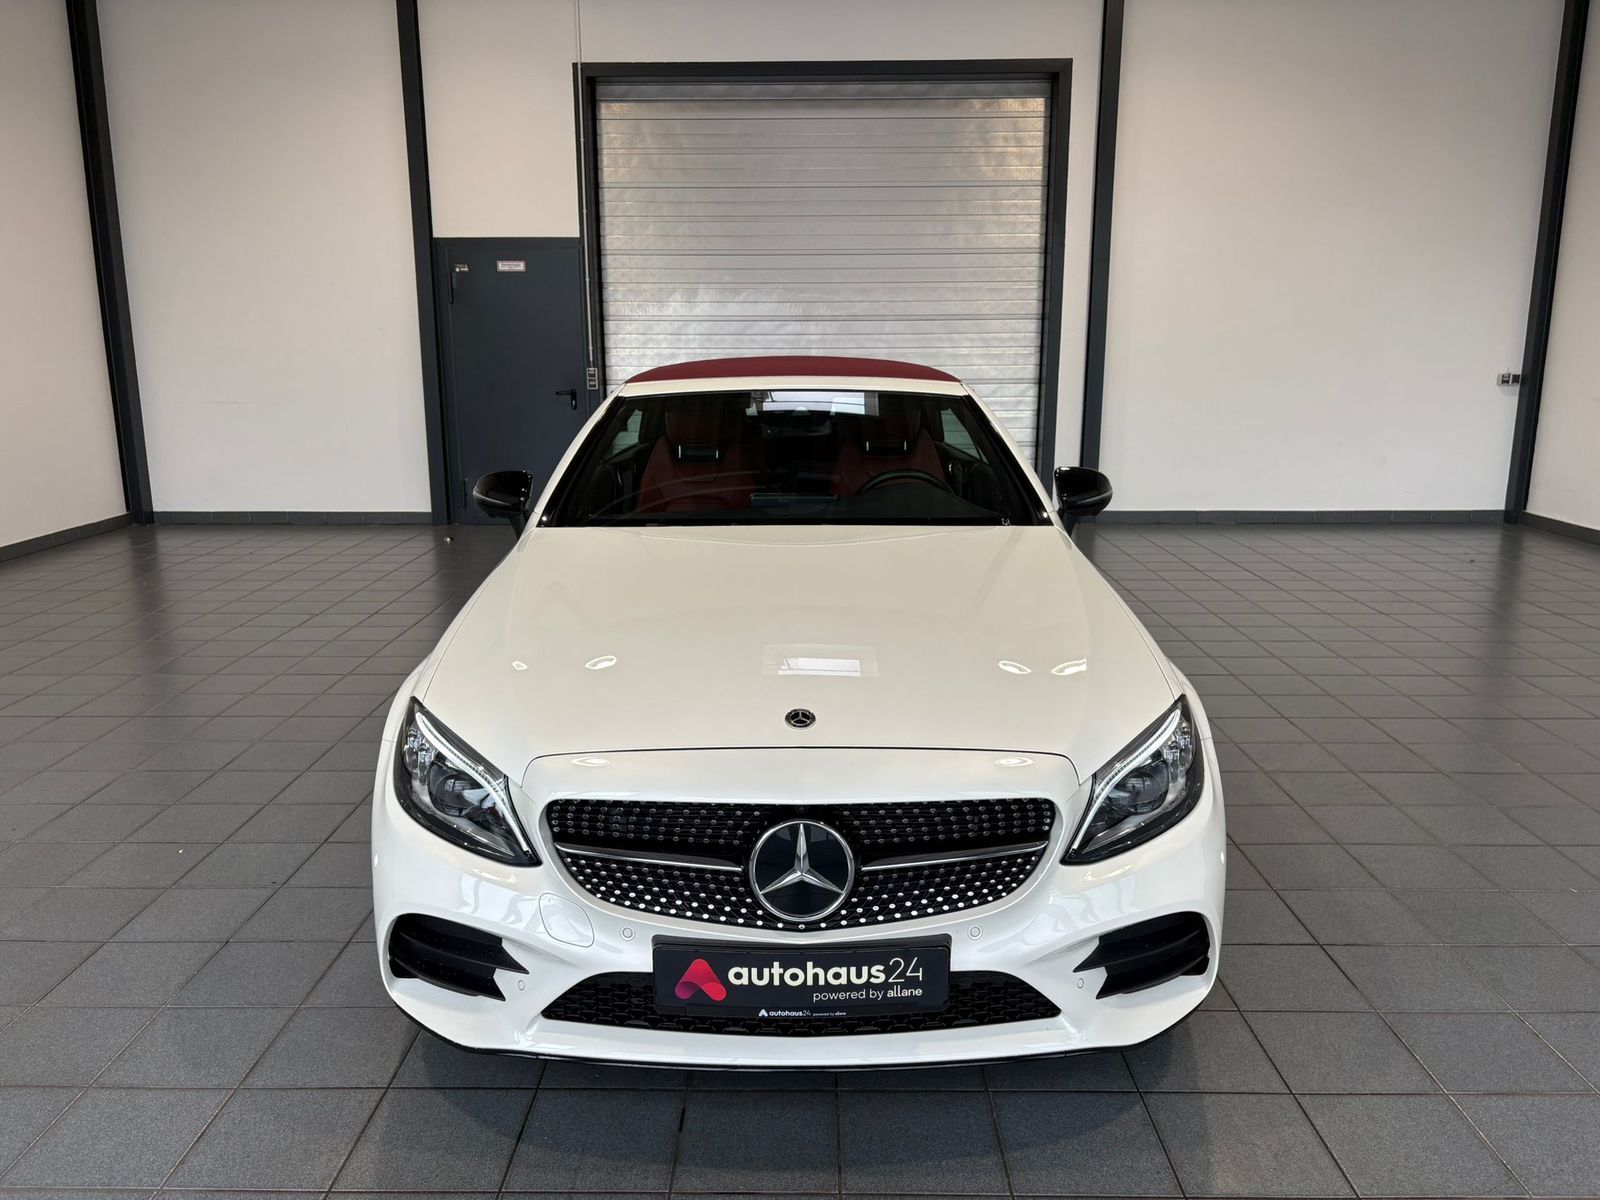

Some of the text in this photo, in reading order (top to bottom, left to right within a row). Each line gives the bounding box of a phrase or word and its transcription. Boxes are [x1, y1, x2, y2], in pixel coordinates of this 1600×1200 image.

[727, 957, 923, 987] autohaus24
[813, 985, 923, 1003] powered by allane
[769, 1009, 811, 1017] autohaus24
